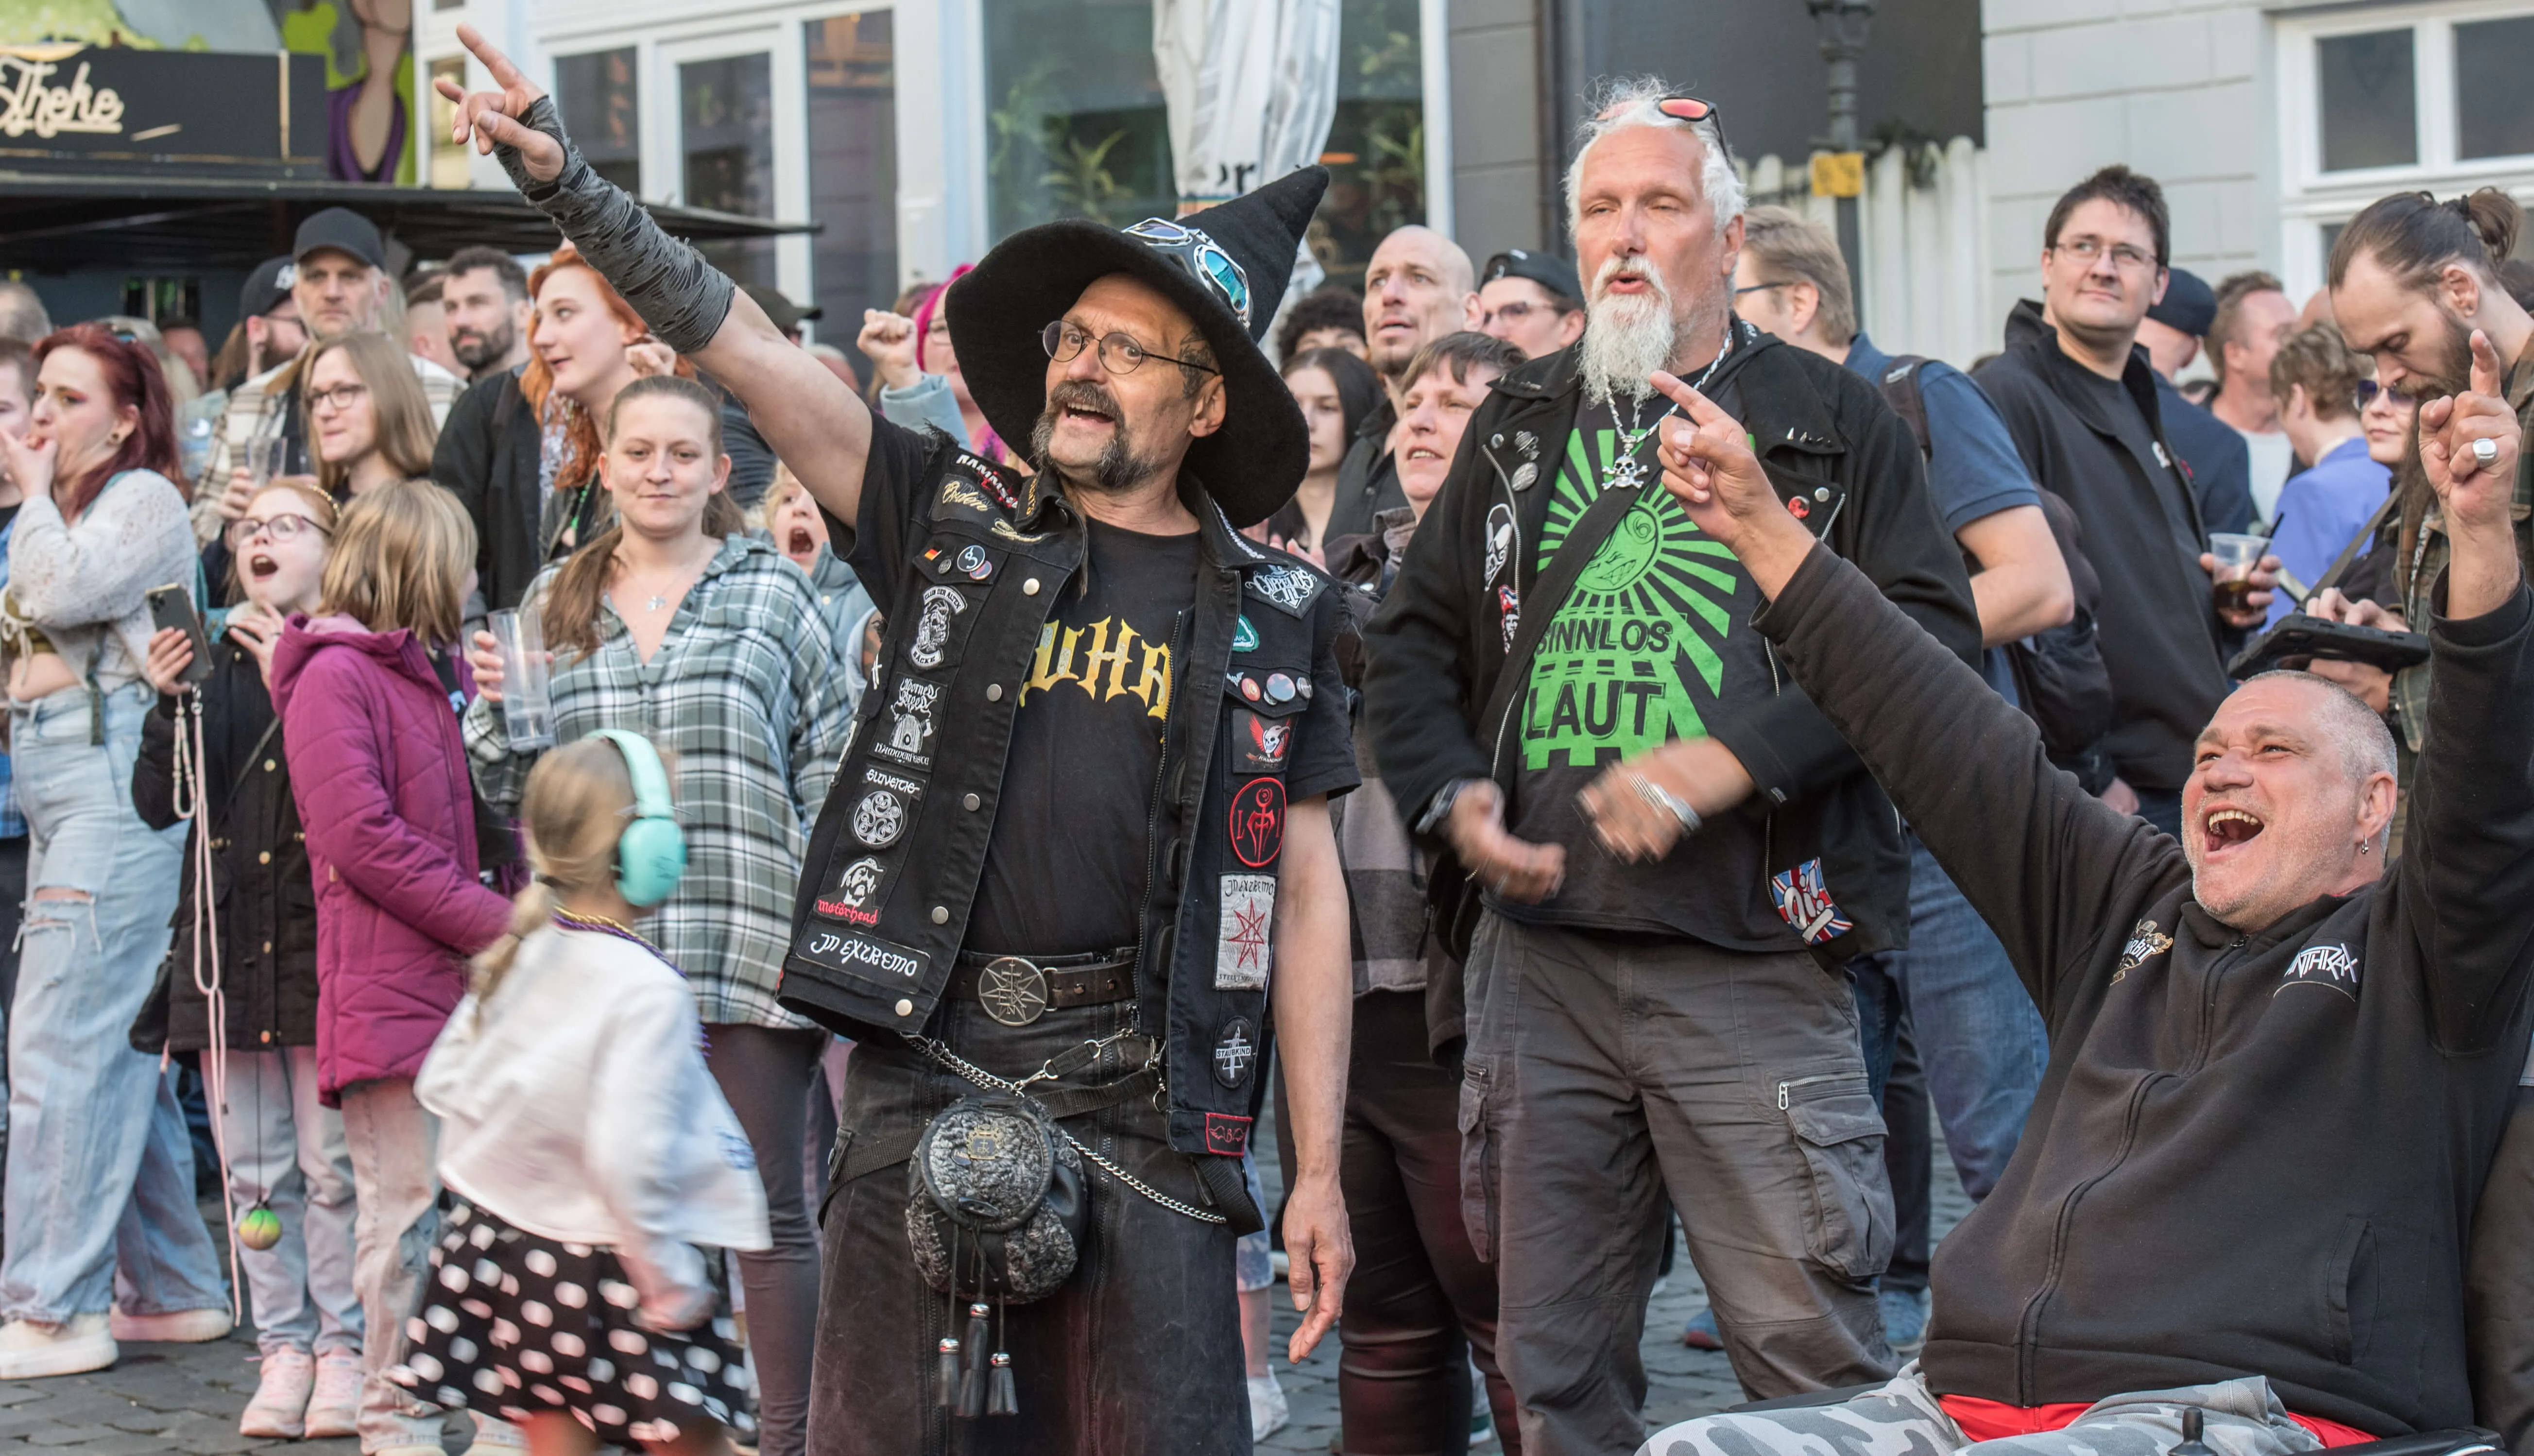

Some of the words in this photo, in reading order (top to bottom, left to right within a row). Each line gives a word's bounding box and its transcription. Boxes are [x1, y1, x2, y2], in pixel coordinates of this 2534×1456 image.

[1536, 618, 1674, 656] SINNLOS
[1525, 679, 1667, 740] LAUT
[2284, 942, 2359, 983] ANTHRAX
[1216, 1047, 1251, 1058] STAUBKIND
